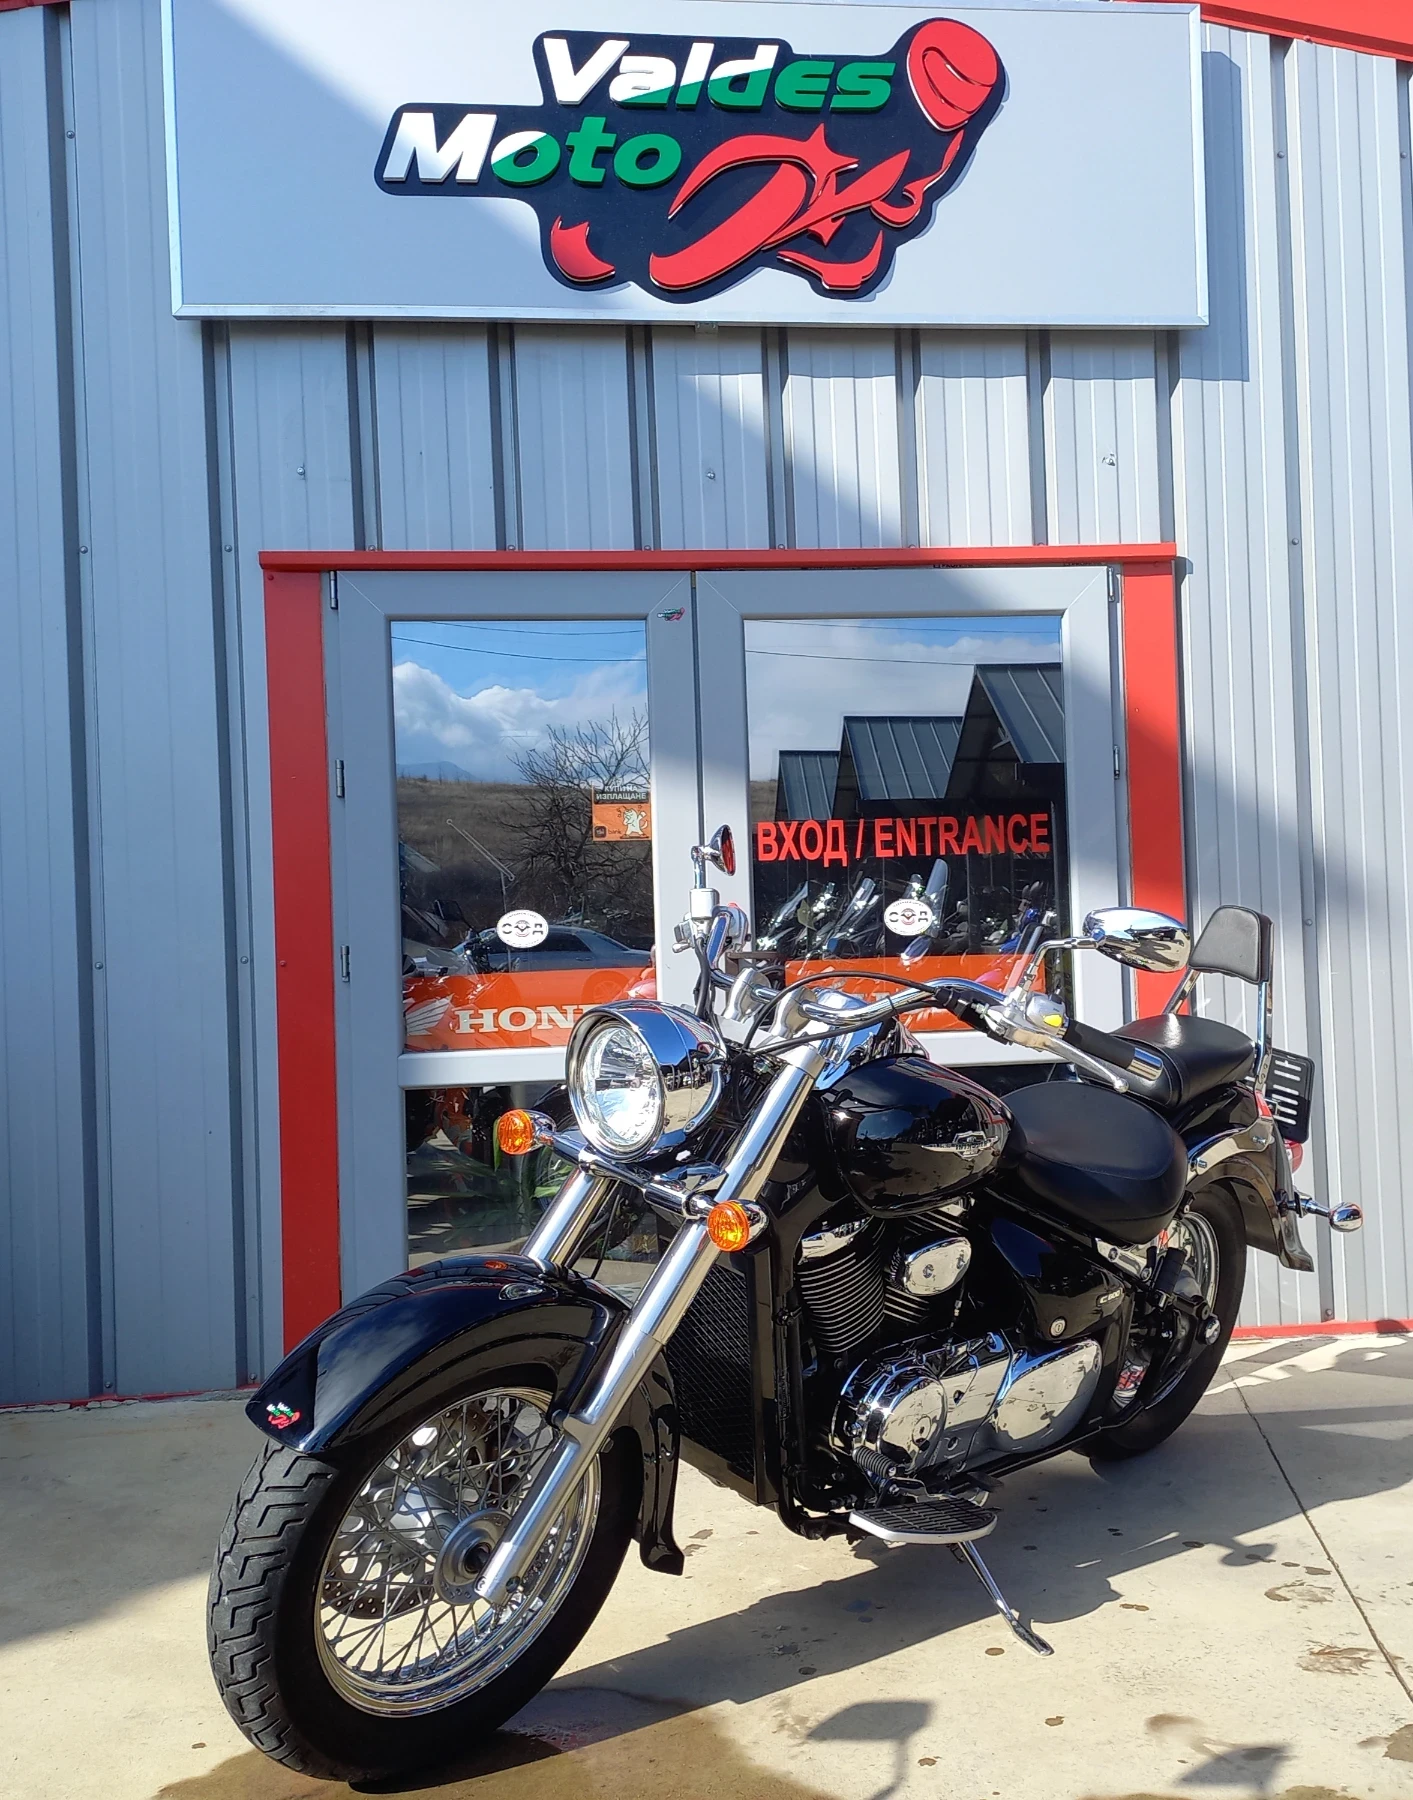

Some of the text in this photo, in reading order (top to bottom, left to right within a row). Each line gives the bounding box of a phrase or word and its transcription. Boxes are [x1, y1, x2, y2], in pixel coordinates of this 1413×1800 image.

[542, 37, 897, 112] Valdes
[382, 111, 683, 187] Moto
[757, 813, 1050, 868] ВХОД / ENTRANCE
[454, 1004, 602, 1034] HON
